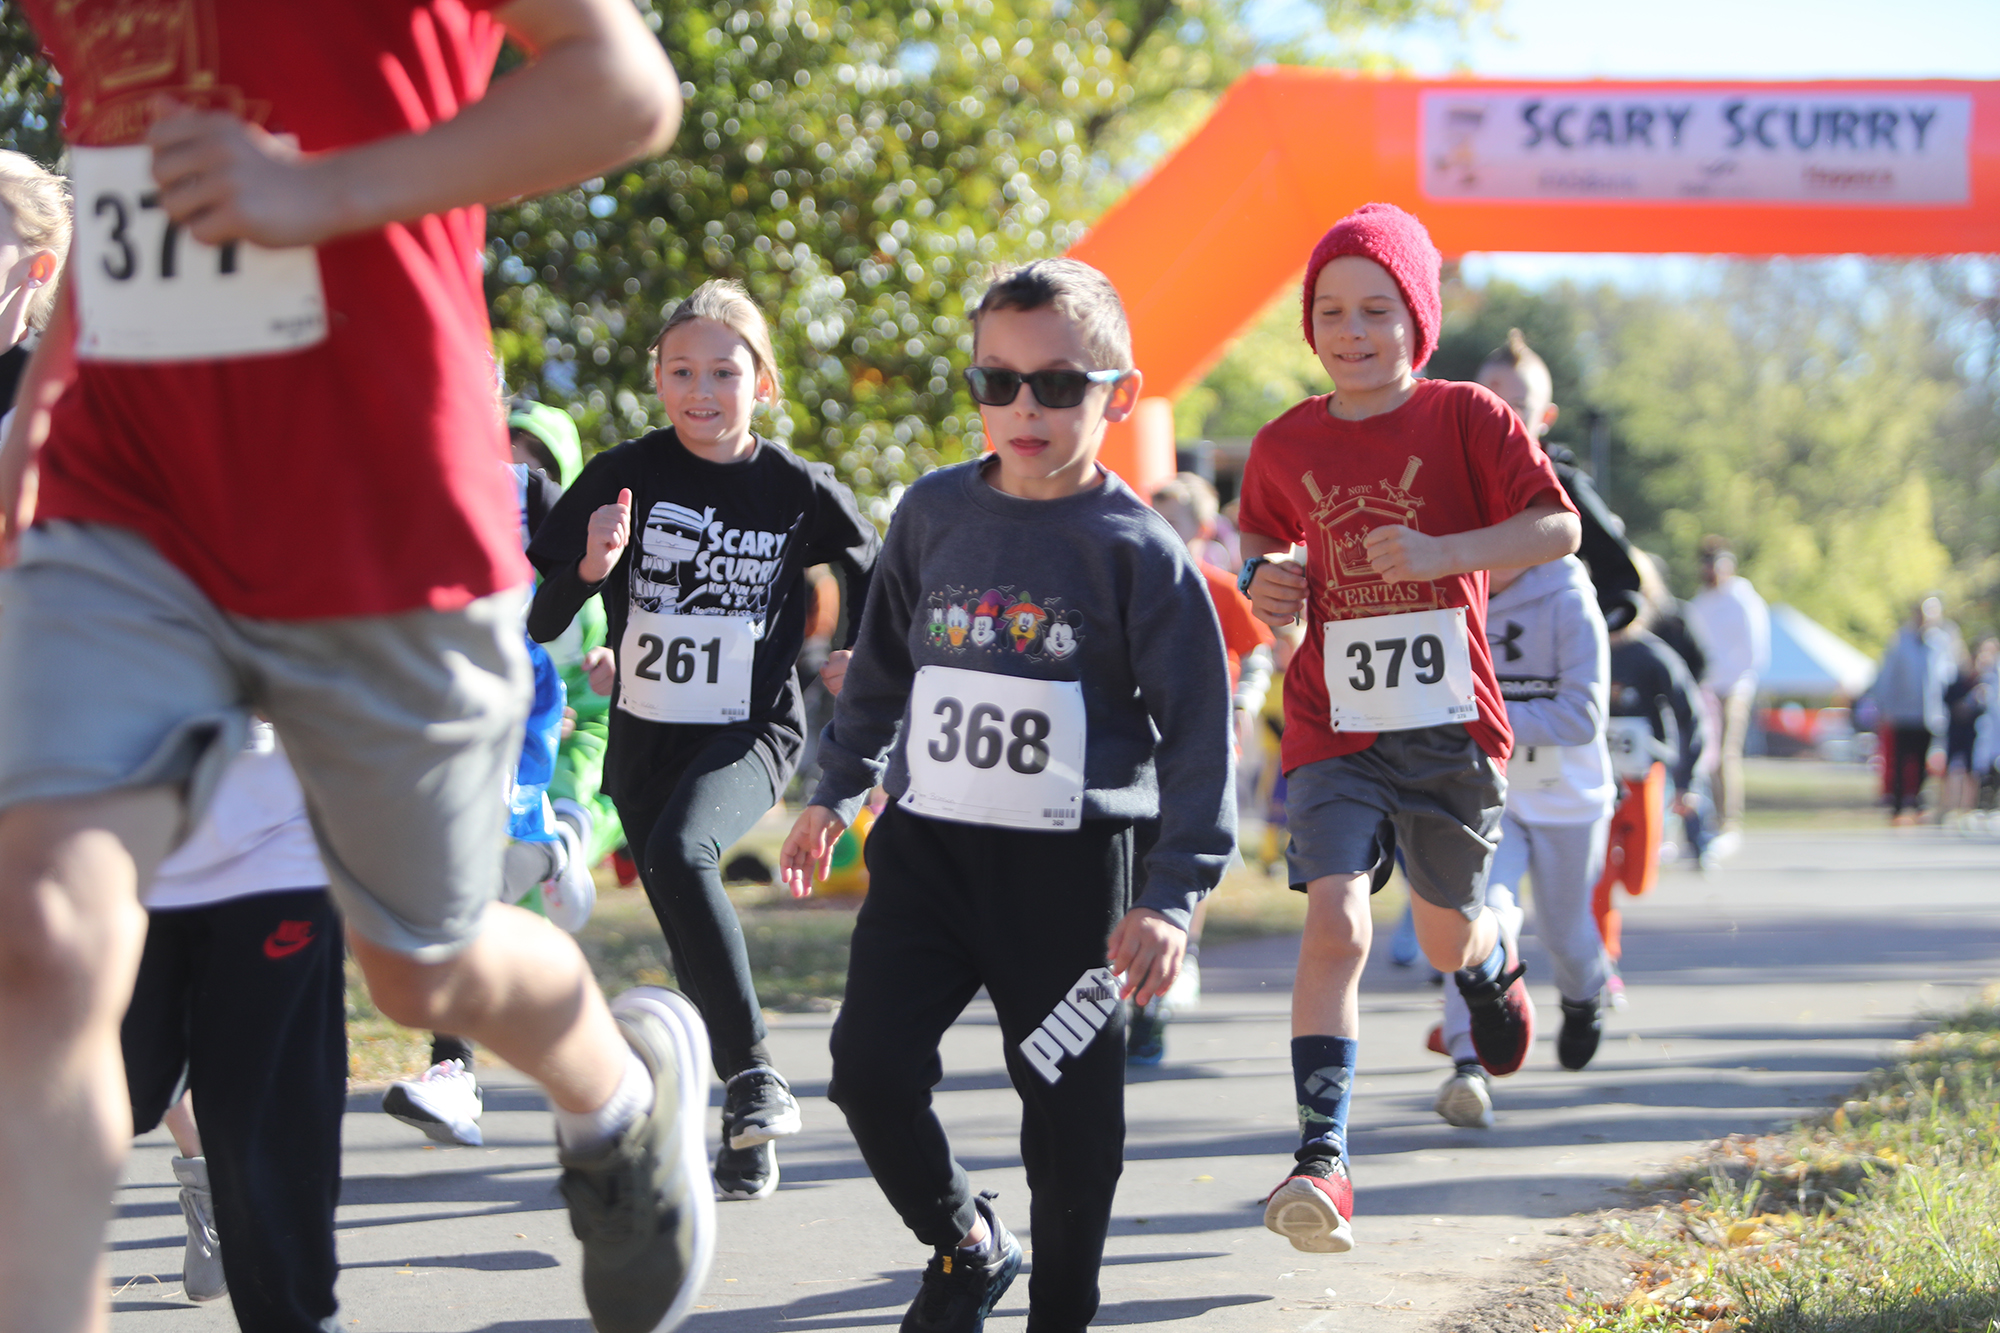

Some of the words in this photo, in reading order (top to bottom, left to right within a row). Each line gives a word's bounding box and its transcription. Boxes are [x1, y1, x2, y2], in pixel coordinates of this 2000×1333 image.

[1521, 100, 1693, 149] SCARY
[1723, 100, 1937, 151] SCURRY
[1347, 485, 1373, 496] NGYC
[707, 521, 787, 558] SCARY
[635, 632, 721, 684] 261
[1346, 634, 1446, 691] 379
[928, 696, 1051, 774] 368
[1052, 819, 1065, 827] 368
[1019, 967, 1118, 1084] PUM
